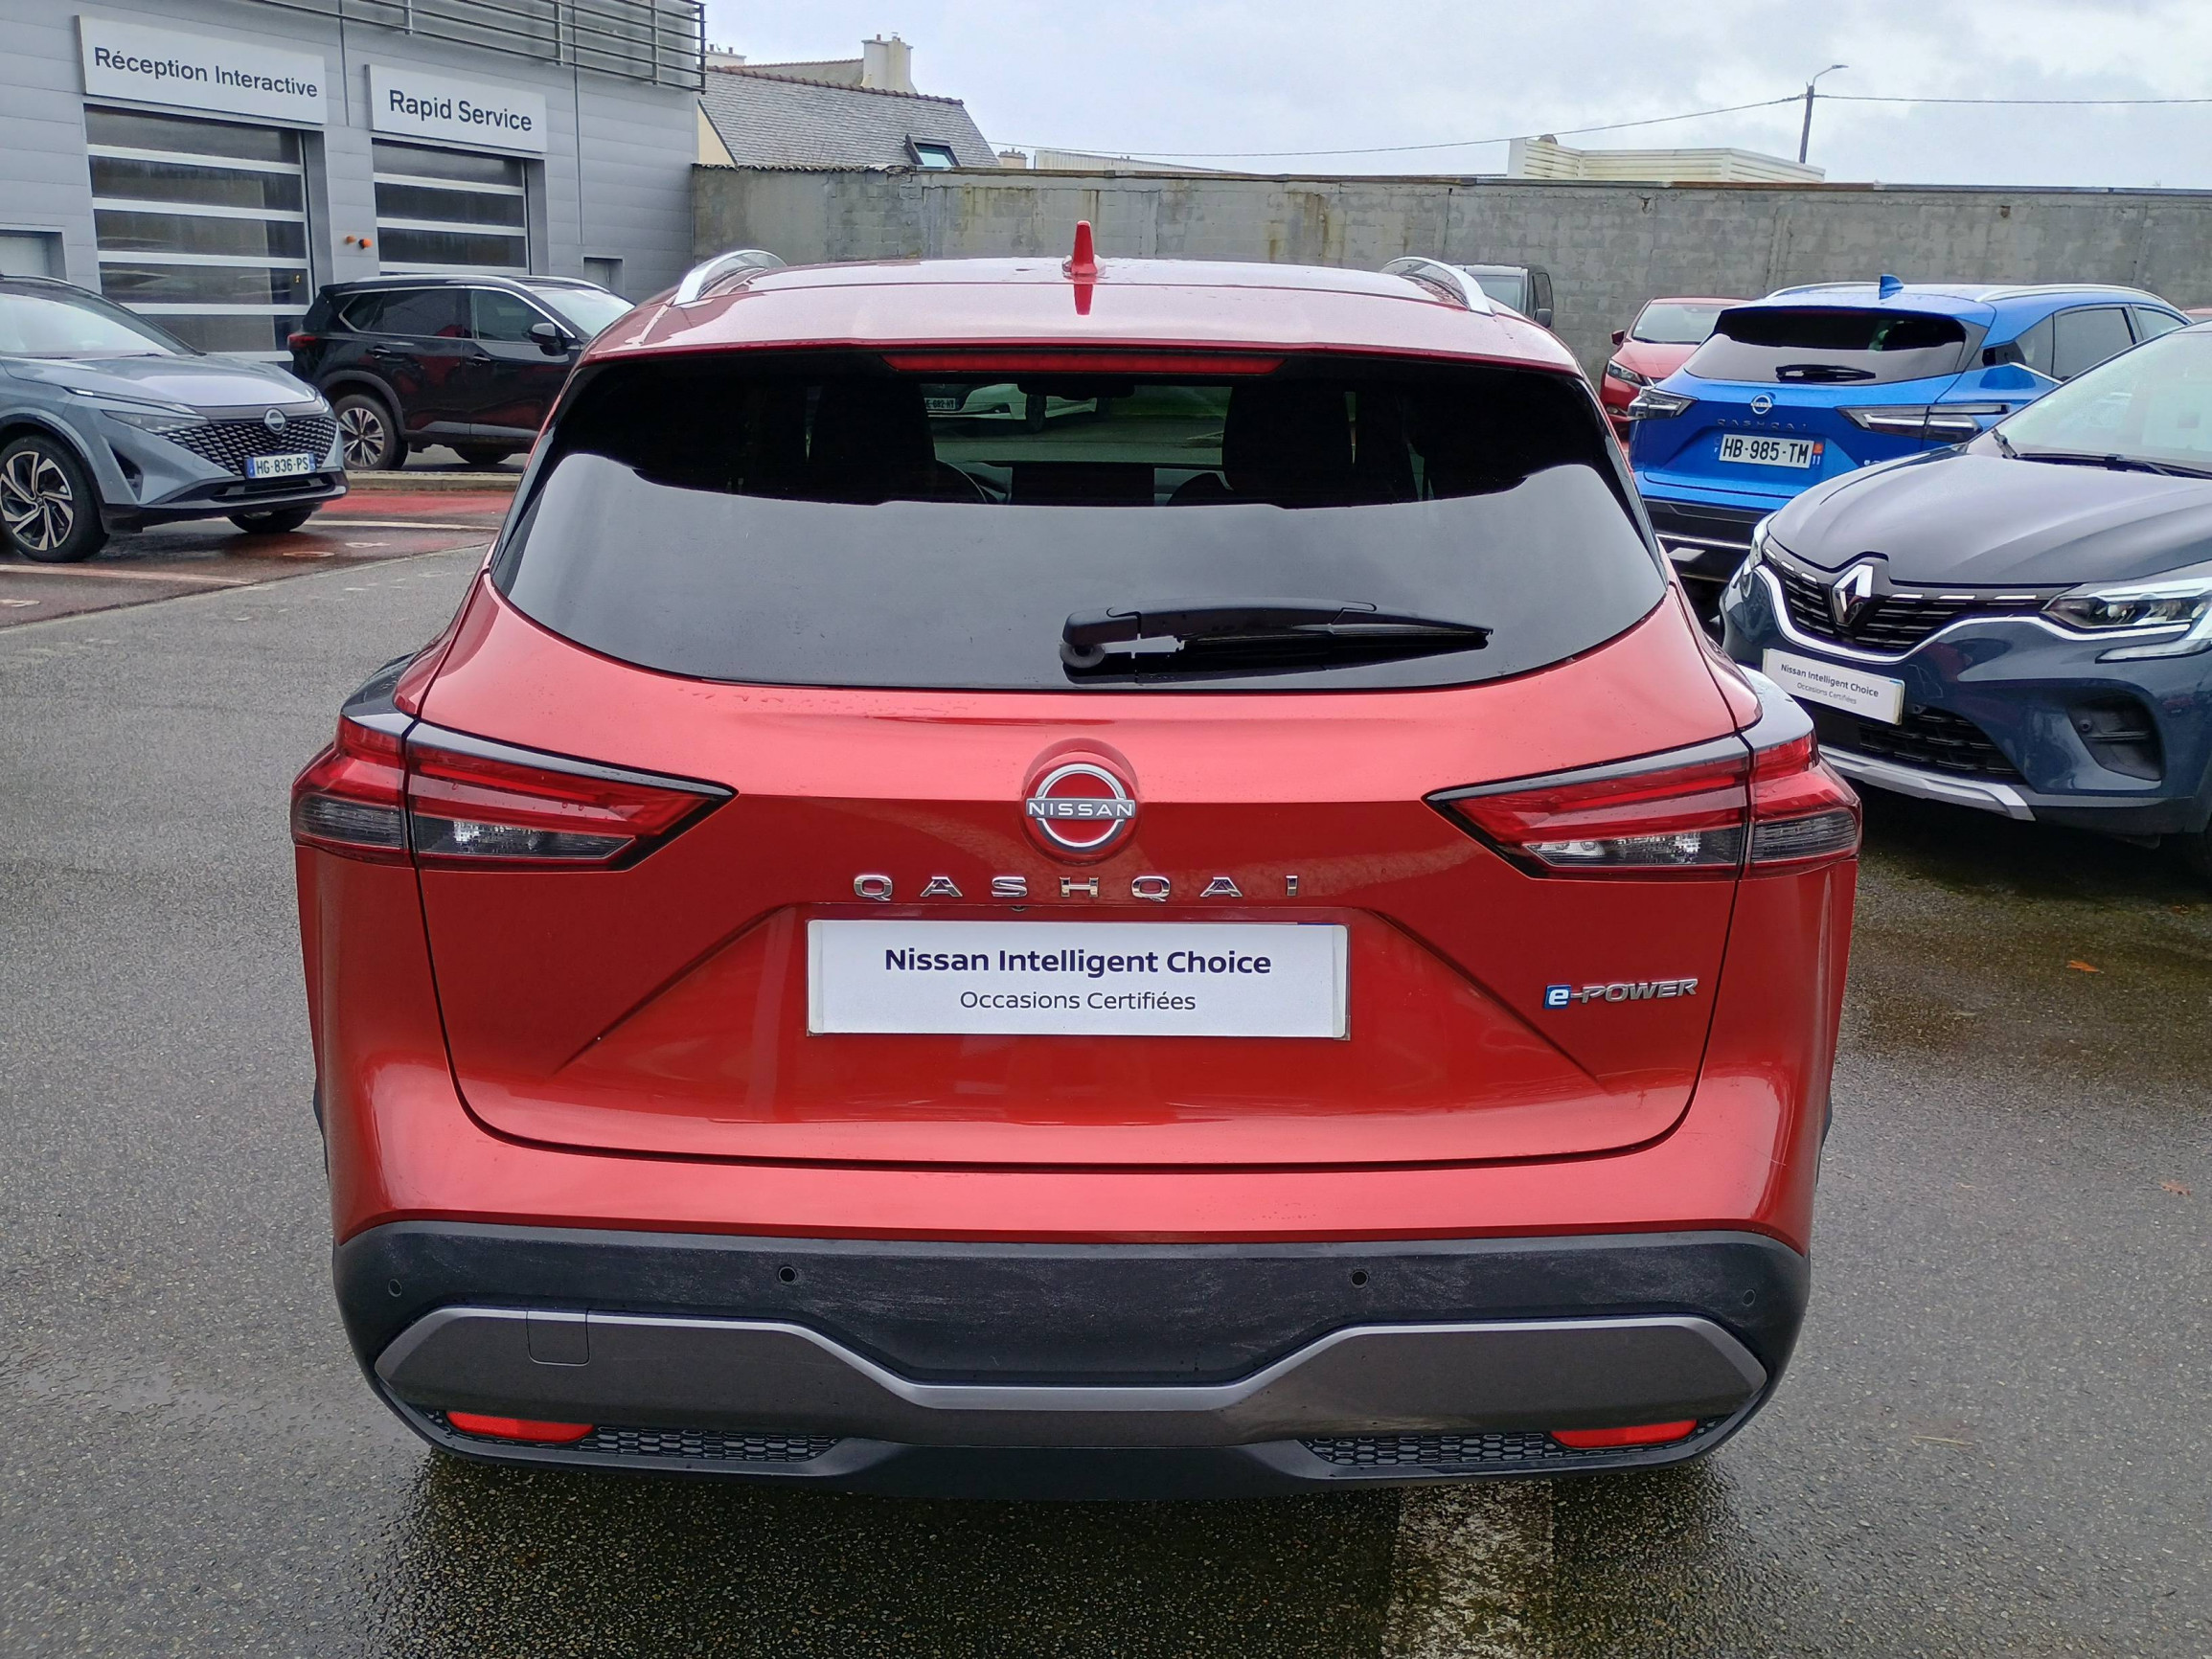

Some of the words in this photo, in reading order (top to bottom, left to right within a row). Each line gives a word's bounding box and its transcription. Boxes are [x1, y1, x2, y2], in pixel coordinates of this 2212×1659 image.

[94, 46, 208, 82] Réception
[216, 65, 318, 98] Interactive
[389, 89, 452, 122] Rapid
[458, 100, 533, 132] Service
[255, 456, 309, 475] HG-836-PS
[1722, 438, 1810, 465] HB-985-TM
[1780, 663, 1807, 678] Nissan
[1808, 670, 1849, 689] Intelligent
[1850, 683, 1880, 697] Choice
[1796, 682, 1828, 696] Occasions
[1028, 802, 1132, 816] NISSAN
[853, 874, 1299, 902] QASHQAI
[884, 947, 990, 972] Nissan
[999, 948, 1159, 978] Intelligent
[1167, 949, 1272, 974] Choice
[959, 990, 1081, 1011] Occasions
[1086, 990, 1197, 1011] Certifiées
[1545, 978, 1699, 1007] e-POWER
